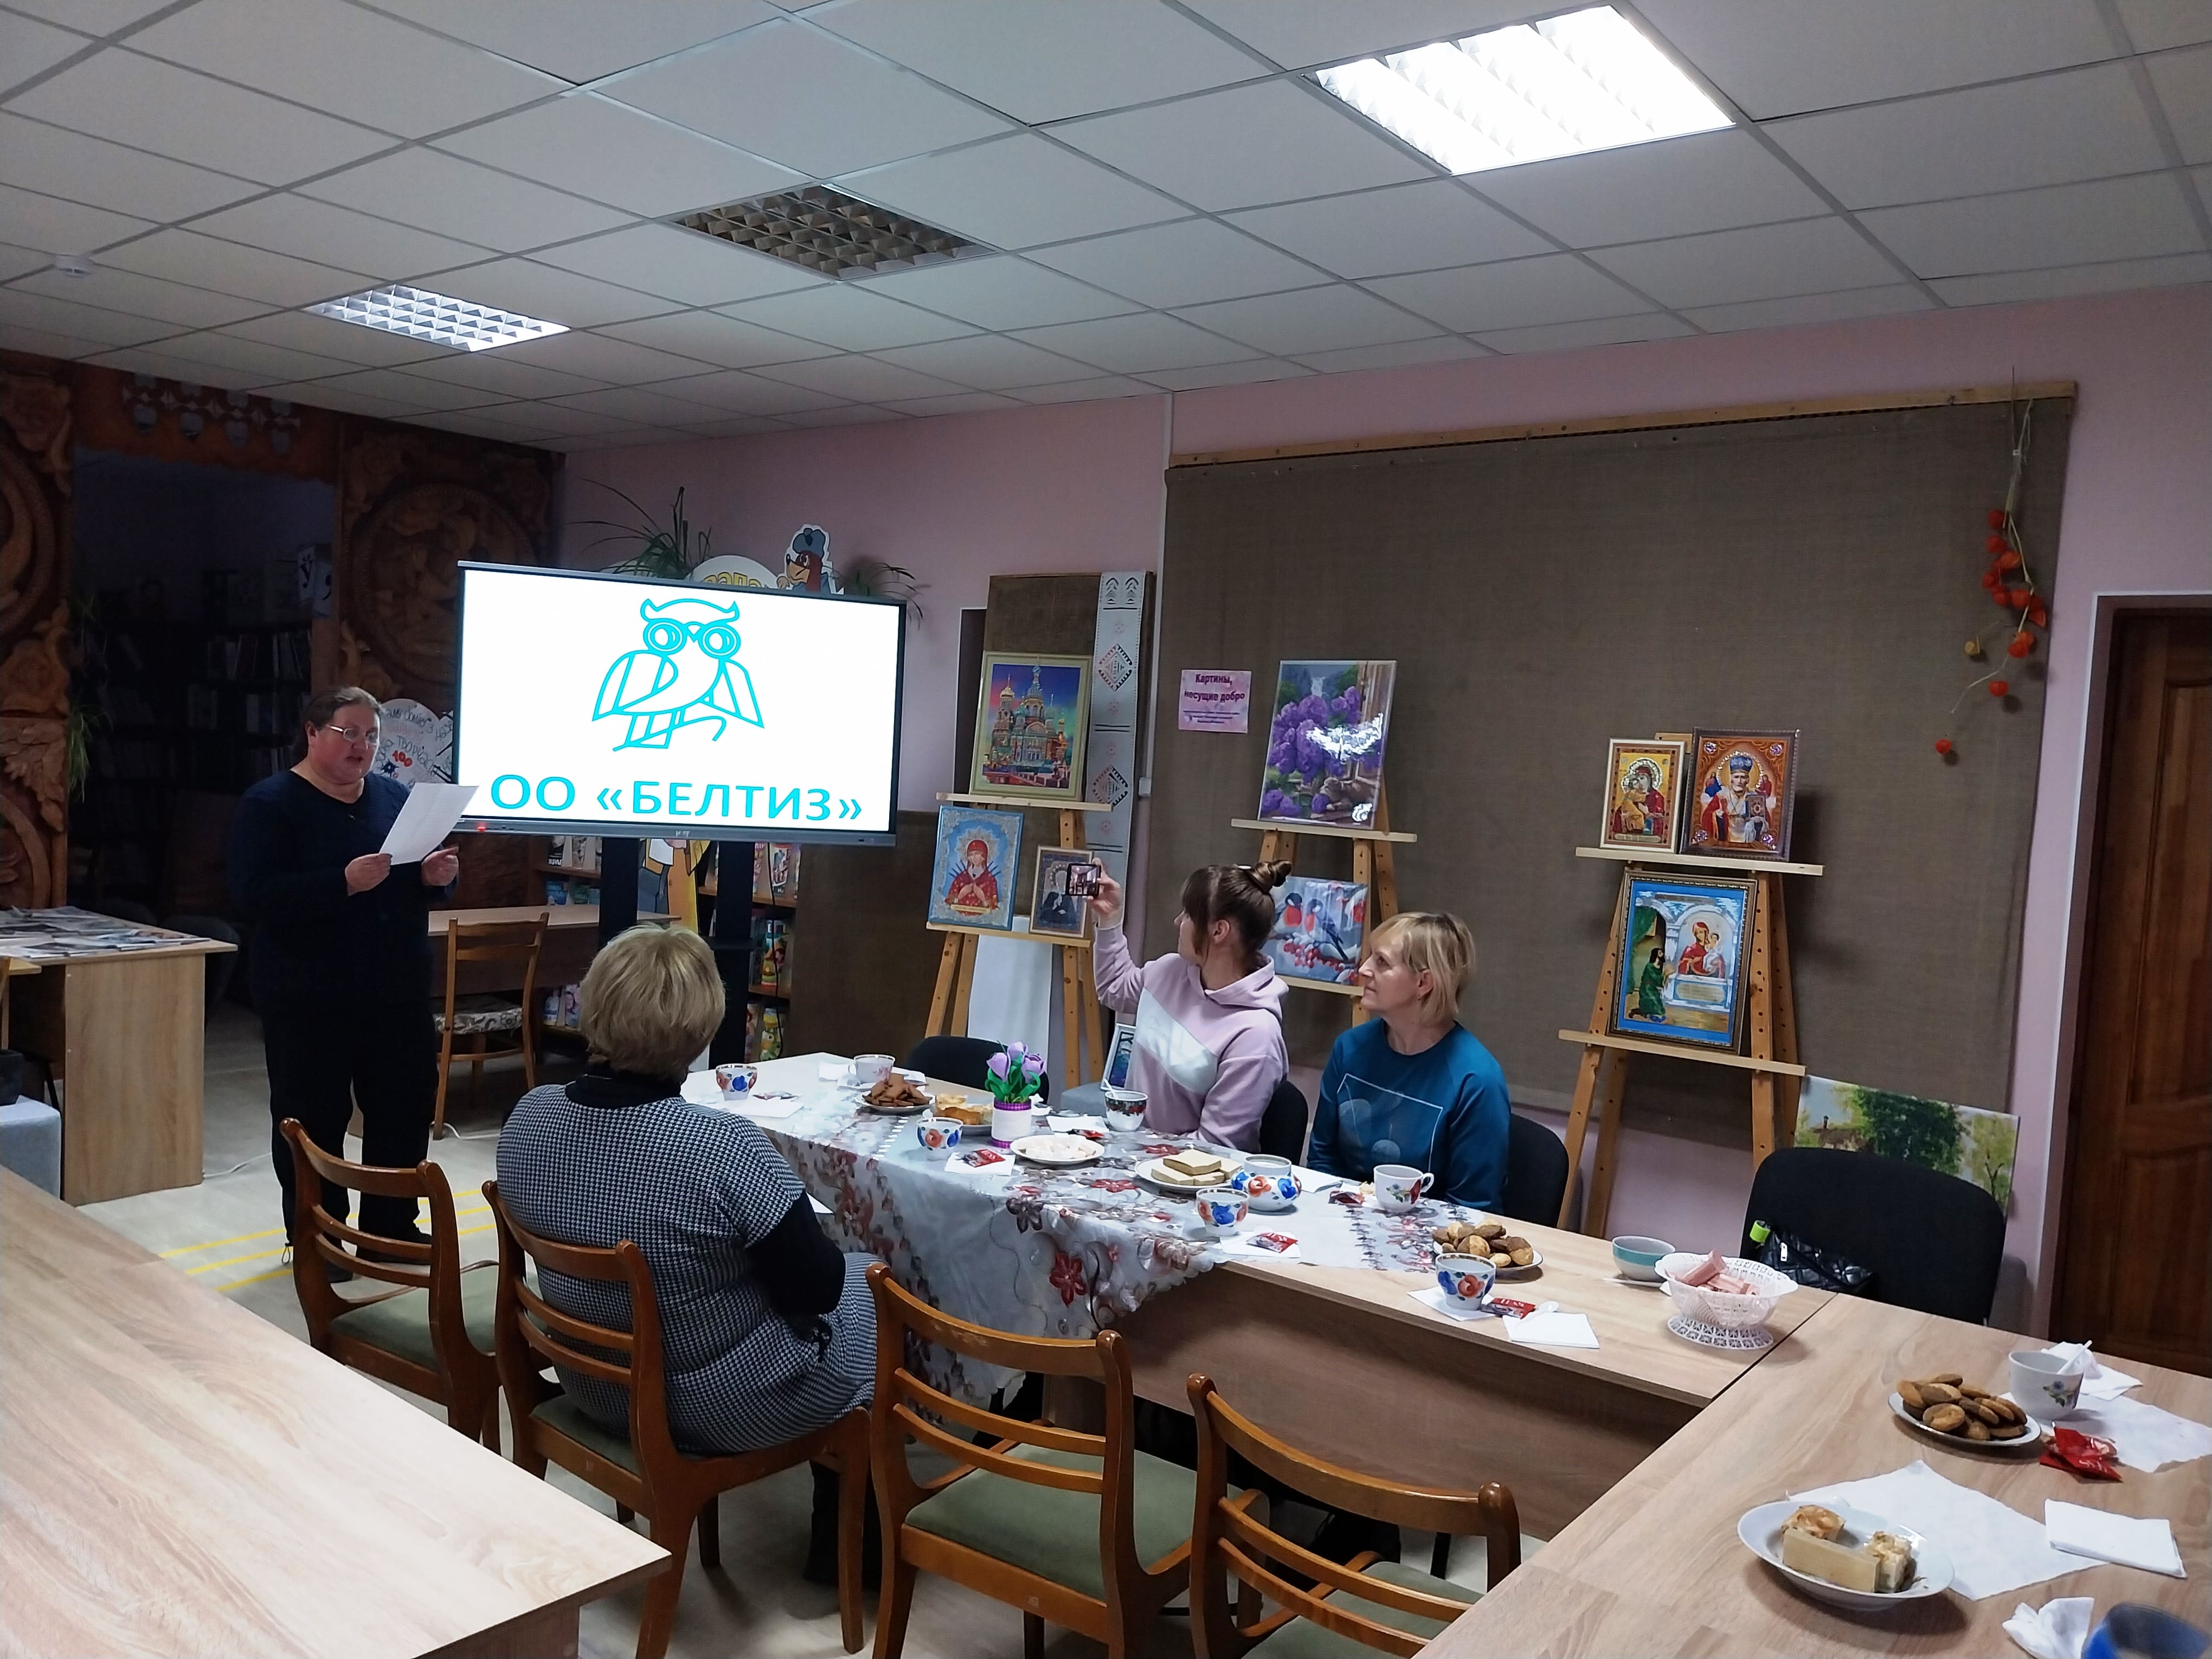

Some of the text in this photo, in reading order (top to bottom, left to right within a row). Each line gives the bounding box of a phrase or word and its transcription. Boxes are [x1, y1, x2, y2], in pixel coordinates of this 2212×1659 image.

[1195, 674, 1232, 686] Картины,
[1184, 690, 1245, 703] несущие добро
[392, 750, 413, 767] 100
[491, 775, 861, 820] ОО «БЕЛТИЗ»
